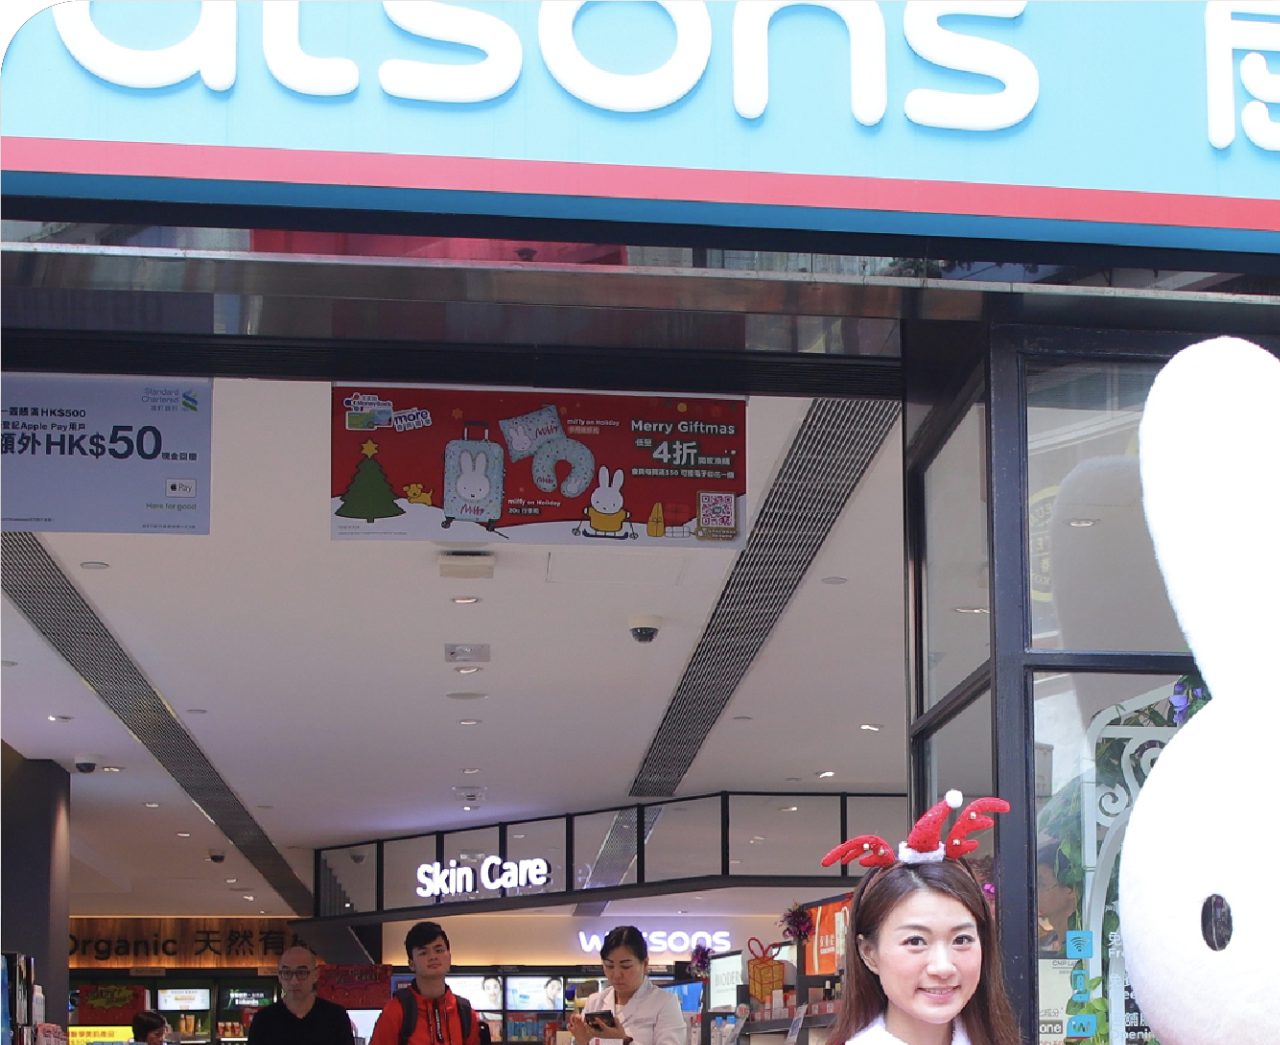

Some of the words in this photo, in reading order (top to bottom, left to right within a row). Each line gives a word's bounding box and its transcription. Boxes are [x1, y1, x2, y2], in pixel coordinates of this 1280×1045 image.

[394, 411, 428, 425] more
[631, 420, 674, 434] Merry
[677, 421, 735, 435] Giftmas
[652, 440, 697, 466] 4折
[416, 859, 474, 897] Skin
[480, 855, 549, 891] Care
[578, 930, 731, 953] wsons
